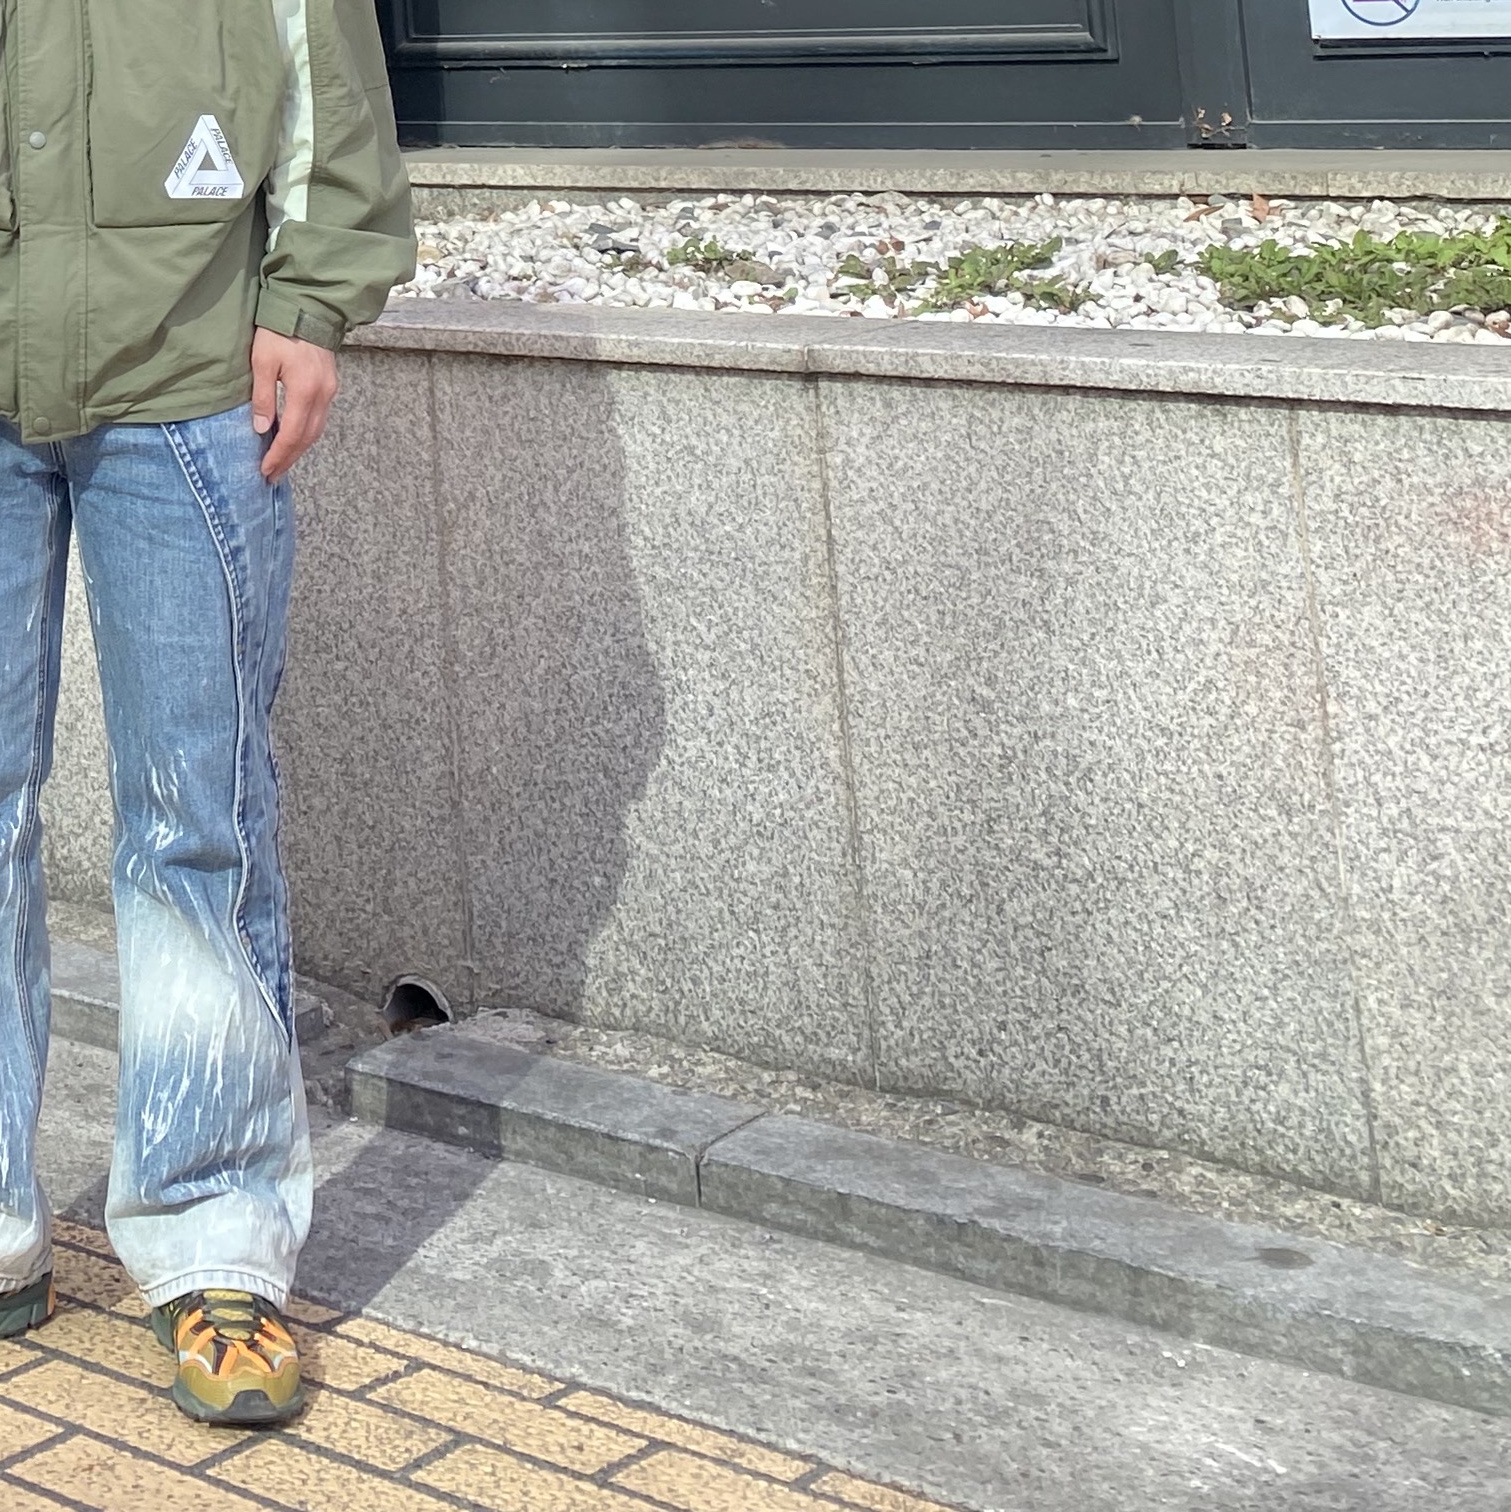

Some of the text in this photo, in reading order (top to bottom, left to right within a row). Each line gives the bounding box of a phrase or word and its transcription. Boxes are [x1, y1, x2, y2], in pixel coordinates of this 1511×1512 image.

[174, 138, 198, 179] PALACE
[210, 128, 233, 165] PALACE
[191, 186, 228, 197] PALACE
